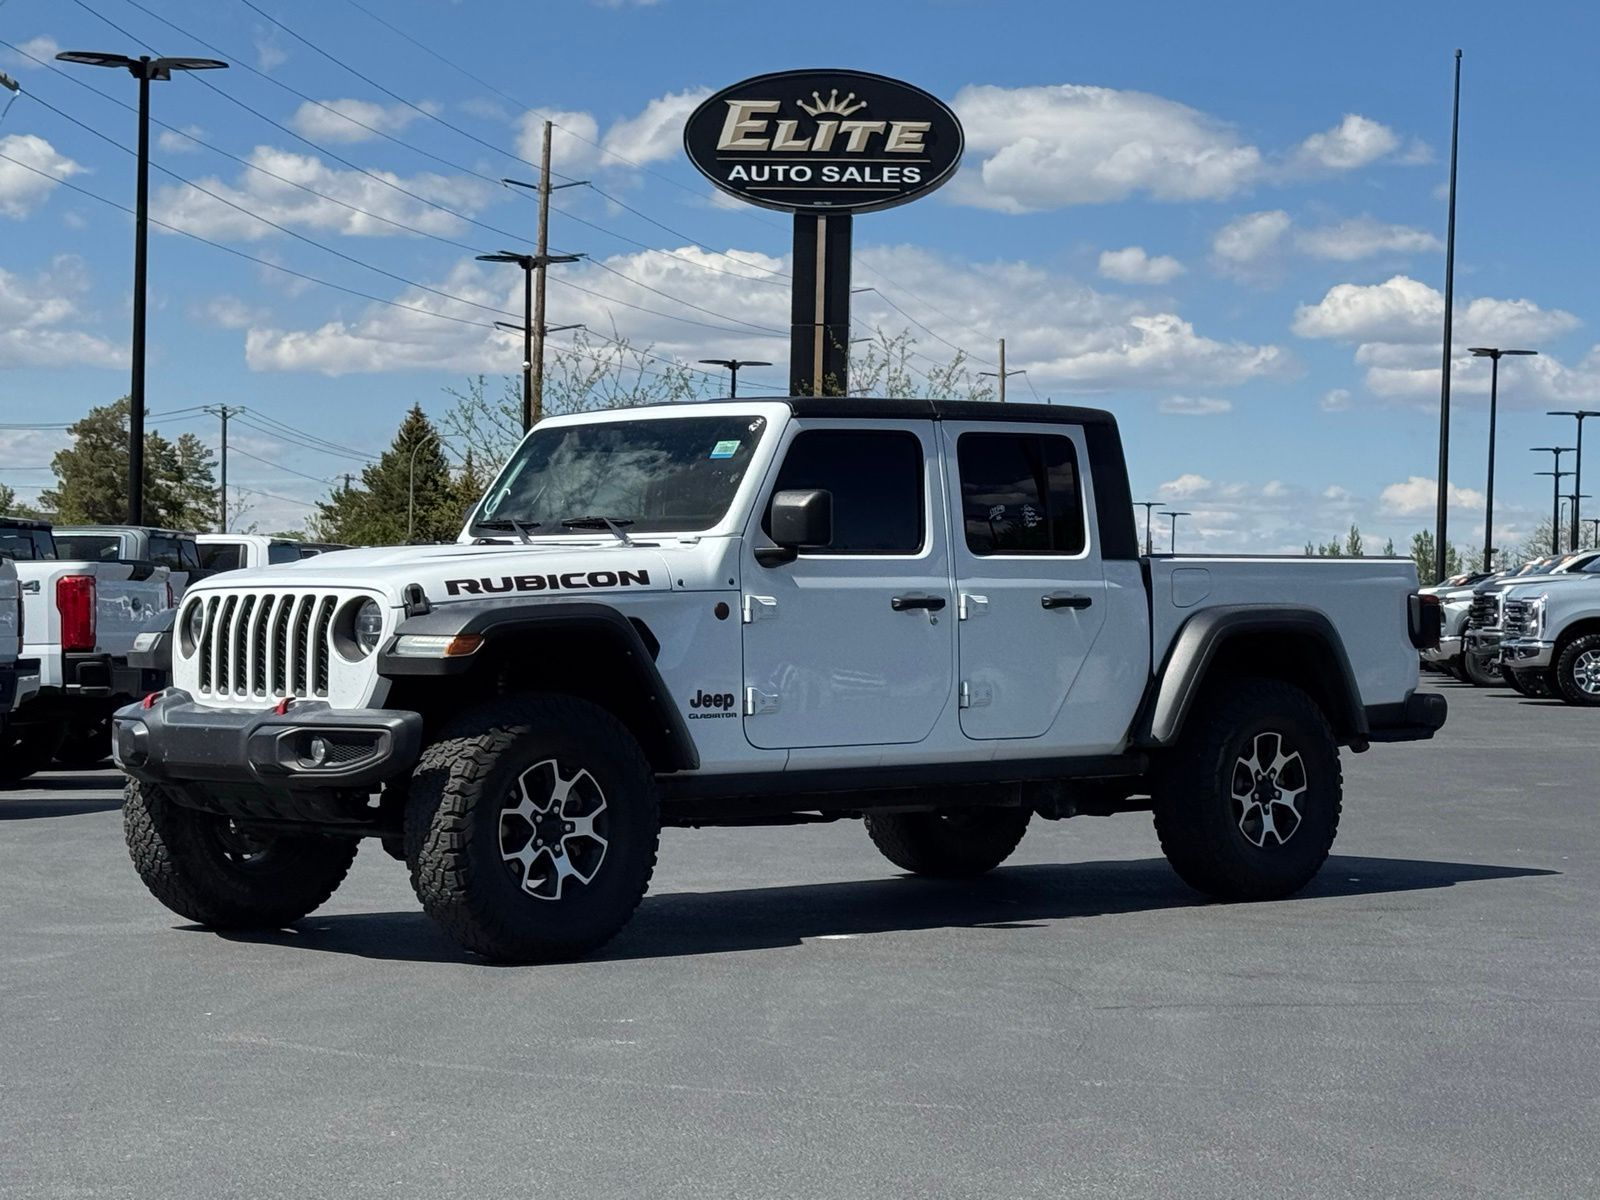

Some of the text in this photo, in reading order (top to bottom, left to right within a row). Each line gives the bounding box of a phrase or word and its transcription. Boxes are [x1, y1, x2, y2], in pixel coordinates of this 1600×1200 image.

[728, 165, 921, 183] AUTO SALES
[445, 570, 650, 595] RUBICON
[690, 690, 734, 711] Jeep
